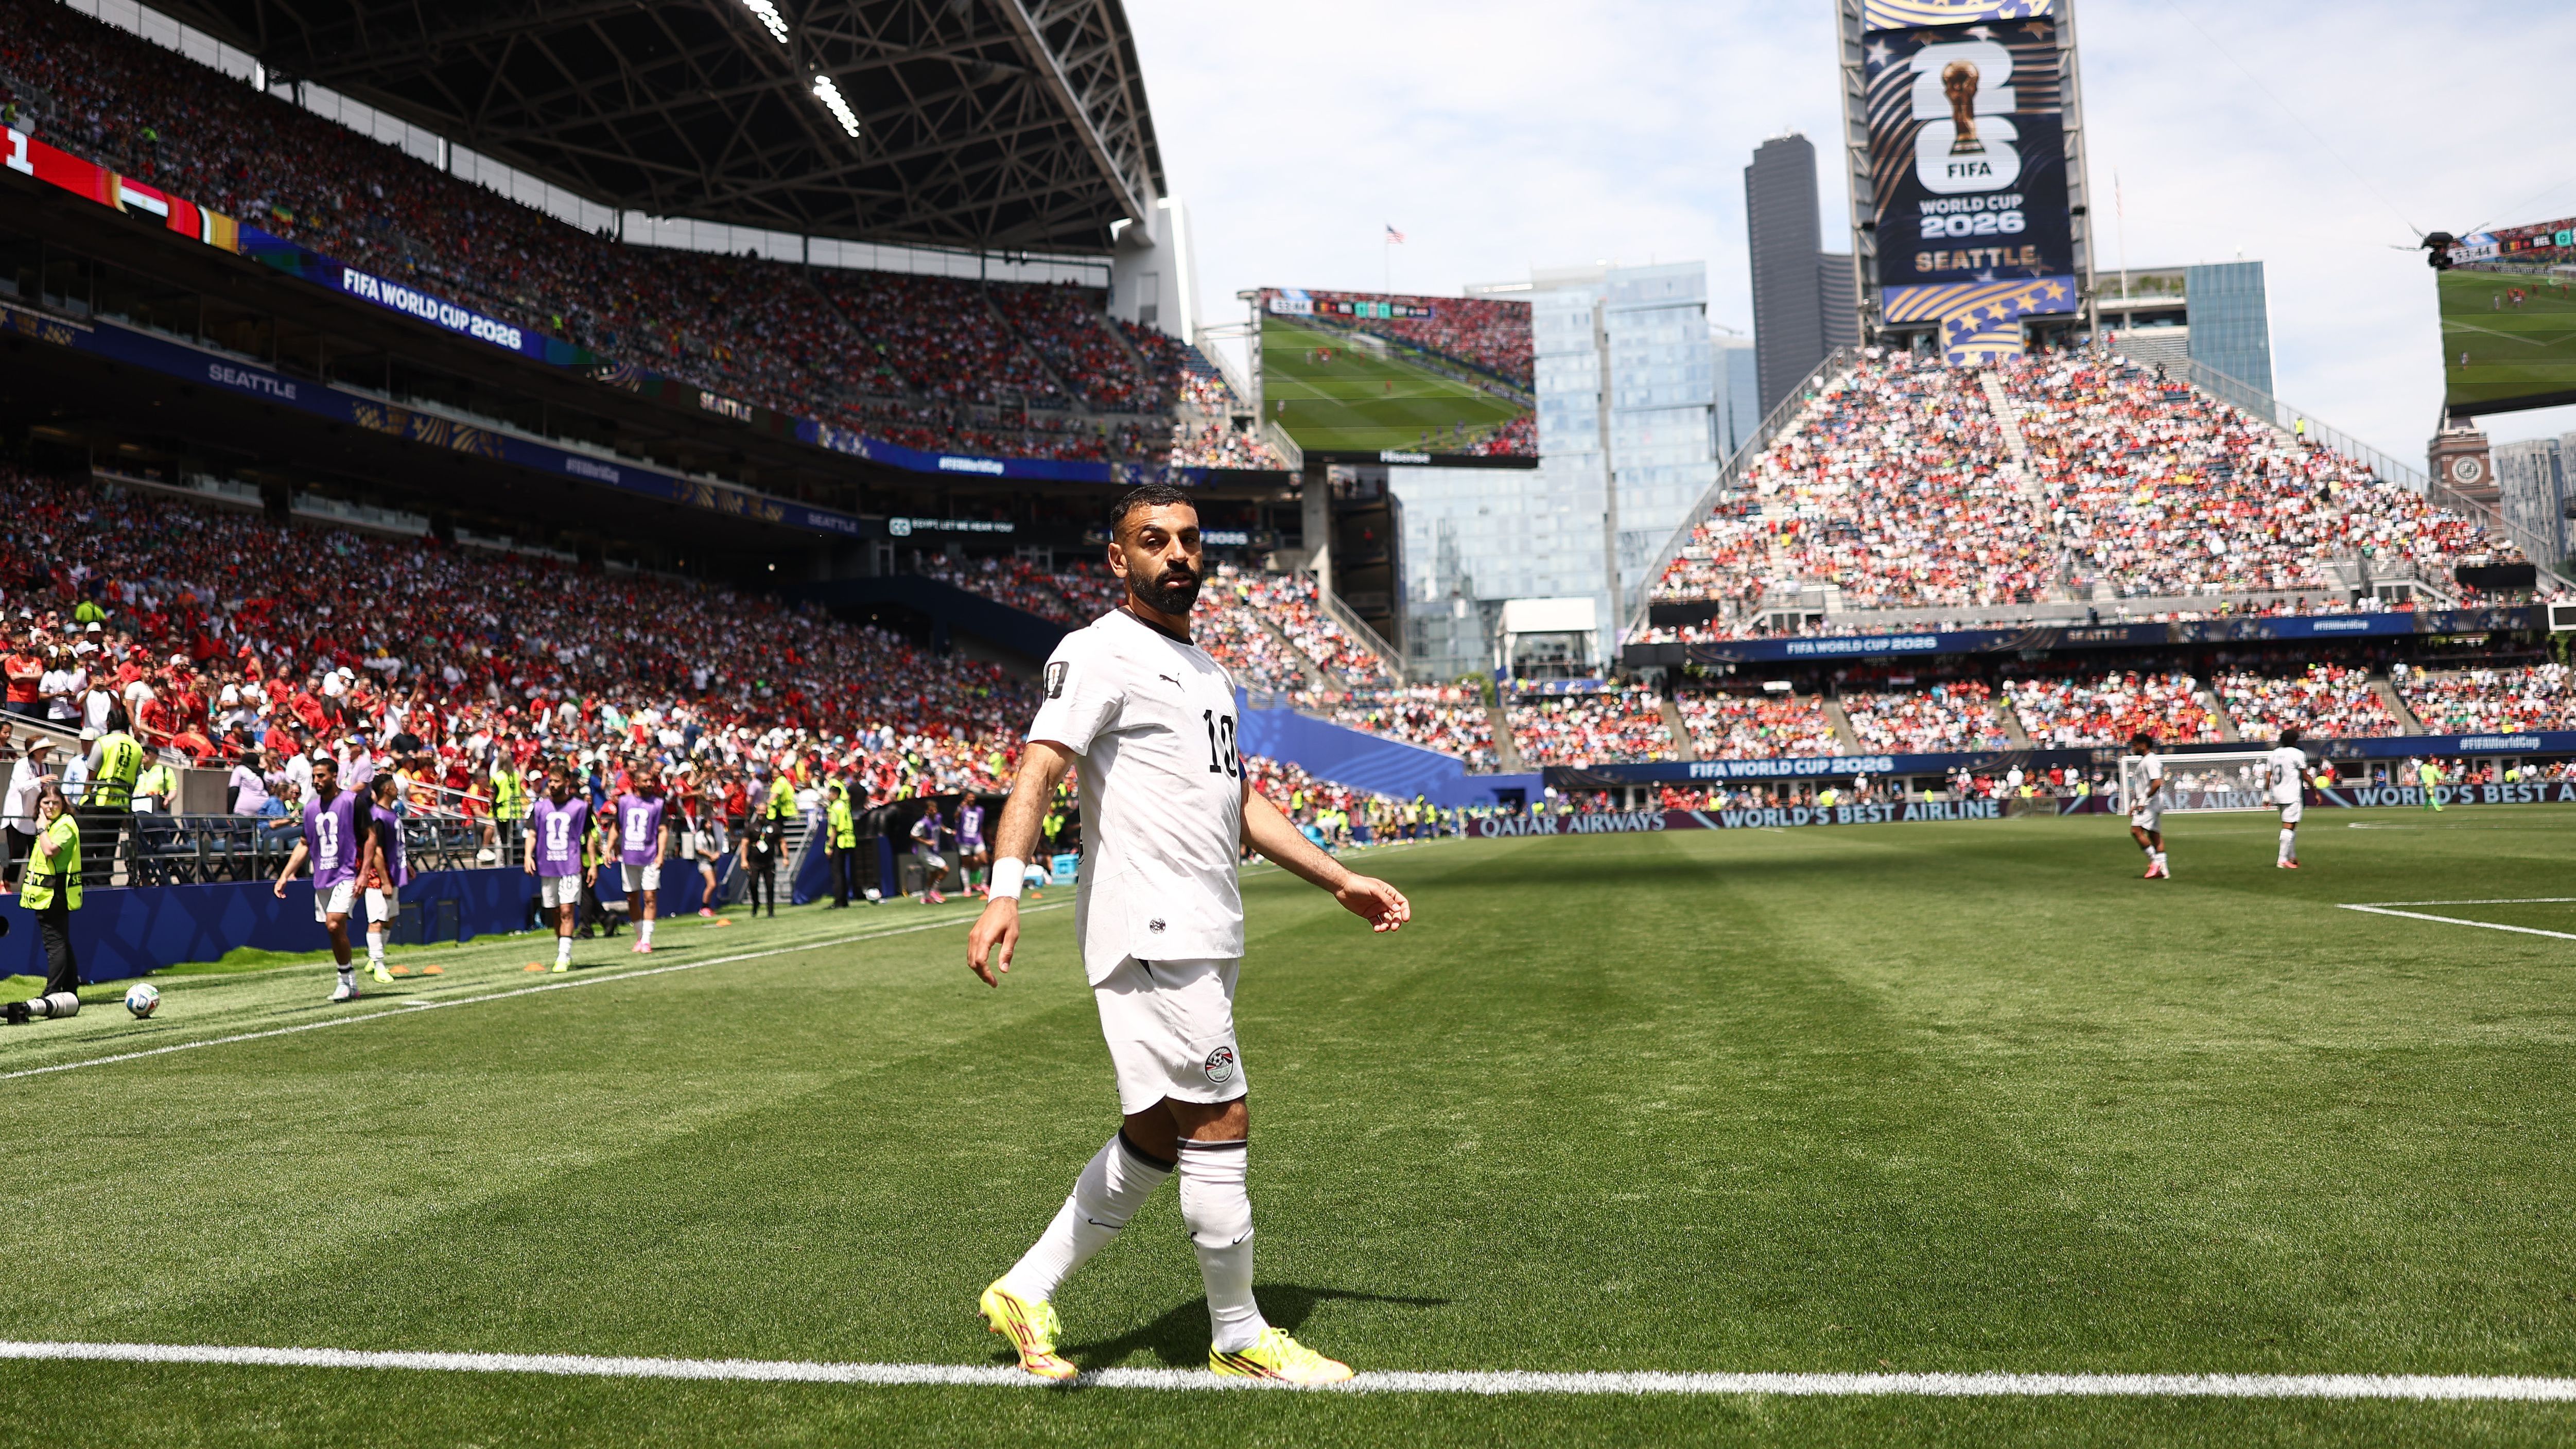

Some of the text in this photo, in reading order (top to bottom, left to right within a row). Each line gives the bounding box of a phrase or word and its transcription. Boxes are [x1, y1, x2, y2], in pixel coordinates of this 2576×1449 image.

[7, 128, 33, 176] 1
[1947, 162, 1992, 178] FIFA
[1919, 193, 2024, 215] WORLD CUP
[1920, 210, 2026, 239] 2026
[1915, 245, 2036, 272] SEATTLE
[343, 267, 522, 350] FIFA WORLD CUP 2026
[209, 363, 297, 400] SEATTLE
[700, 391, 753, 423] SEATTLE
[1380, 450, 1431, 463] Hisense
[1786, 636, 1938, 655] FIFA WORLD CUP 2026
[2067, 628, 2129, 642] SEATTLE
[1203, 709, 1238, 778] 10
[2459, 735, 2542, 750] #FIFAWorldCup
[1689, 755, 1894, 778] FIFA WORLD CUP 2026
[2482, 781, 2549, 804] BEST
[1479, 811, 1667, 839] QATAR AIRWAYS
[1719, 799, 2001, 829] WORLD'S BEST AIRLINE
